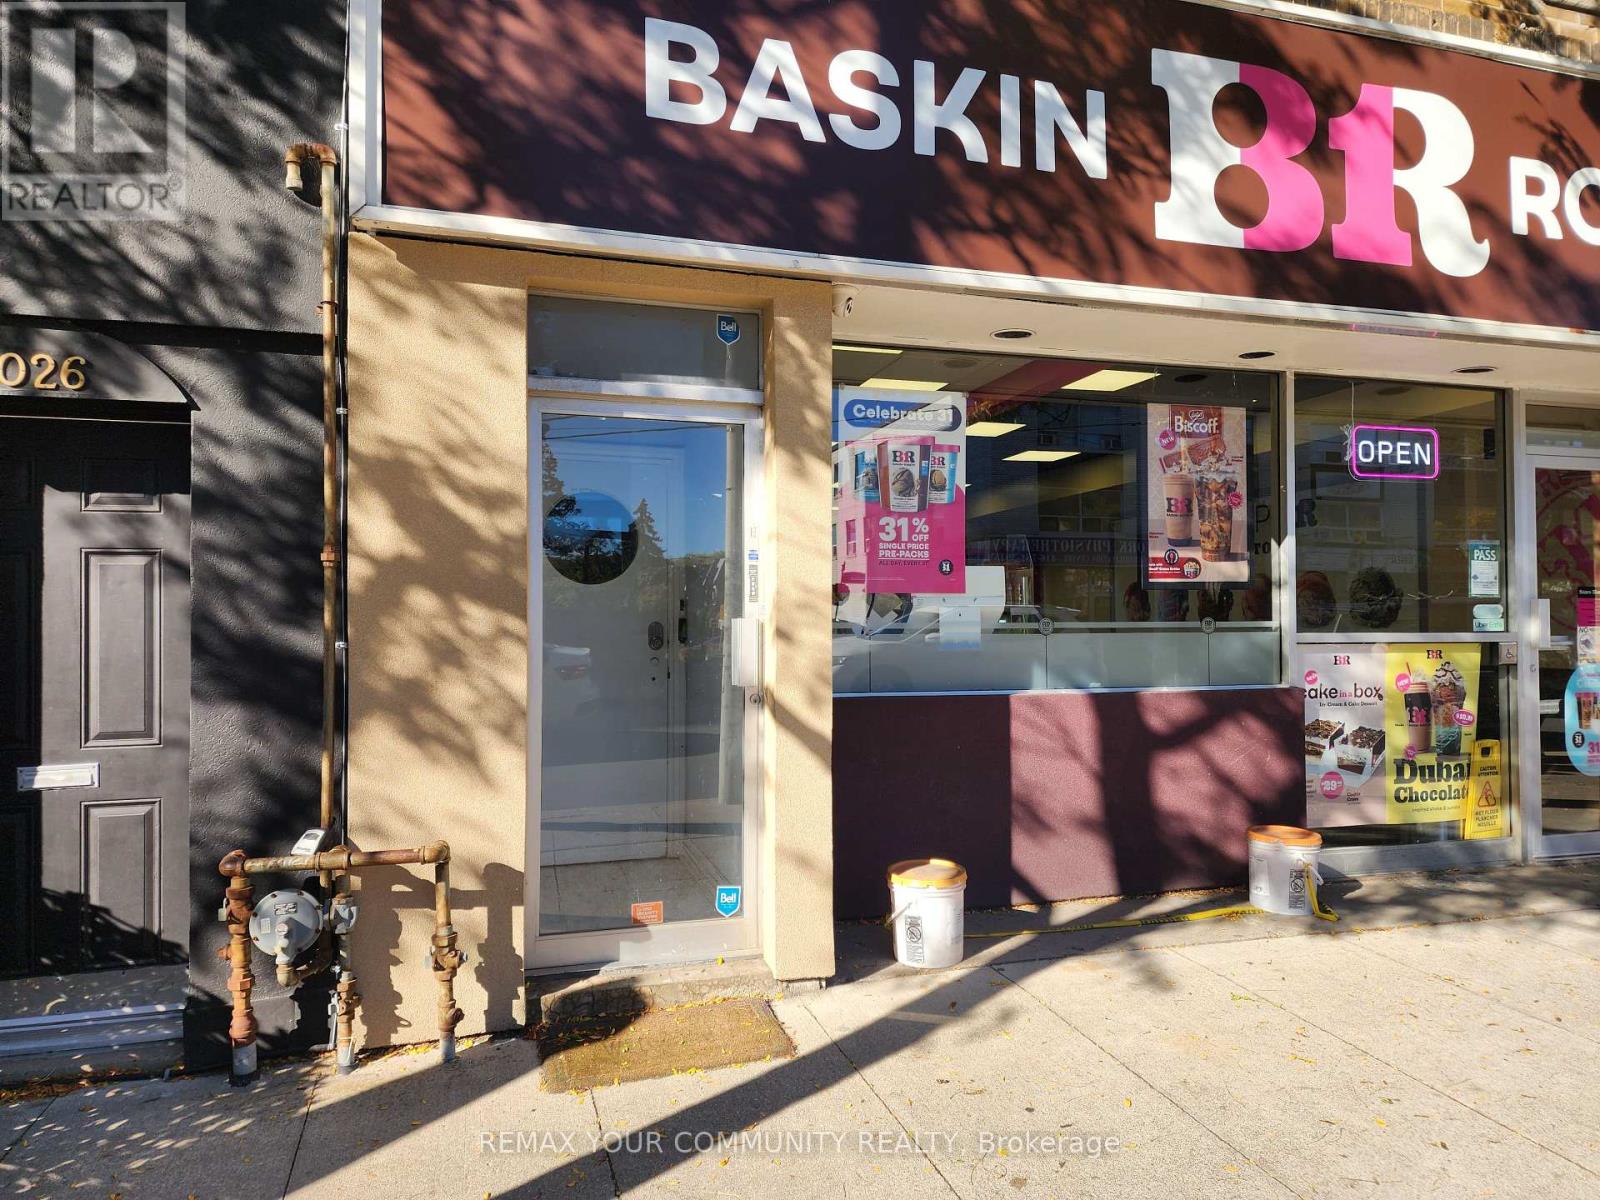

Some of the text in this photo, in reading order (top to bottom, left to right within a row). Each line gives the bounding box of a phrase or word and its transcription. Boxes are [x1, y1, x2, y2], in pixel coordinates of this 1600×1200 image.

[645, 16, 1108, 179] BASKIN
[1509, 156, 1600, 246] RO
[721, 321, 737, 332] Bell
[853, 404, 933, 420] Celebrate
[1174, 415, 1218, 434] Biscoff
[1358, 440, 1431, 465] OPEN
[879, 550, 929, 558] PRE-PACKS
[1474, 549, 1496, 561] PASS
[1339, 690, 1347, 698] in
[1354, 683, 1383, 700] box
[1394, 785, 1468, 803] Chocolat
[720, 893, 736, 903] Bell
